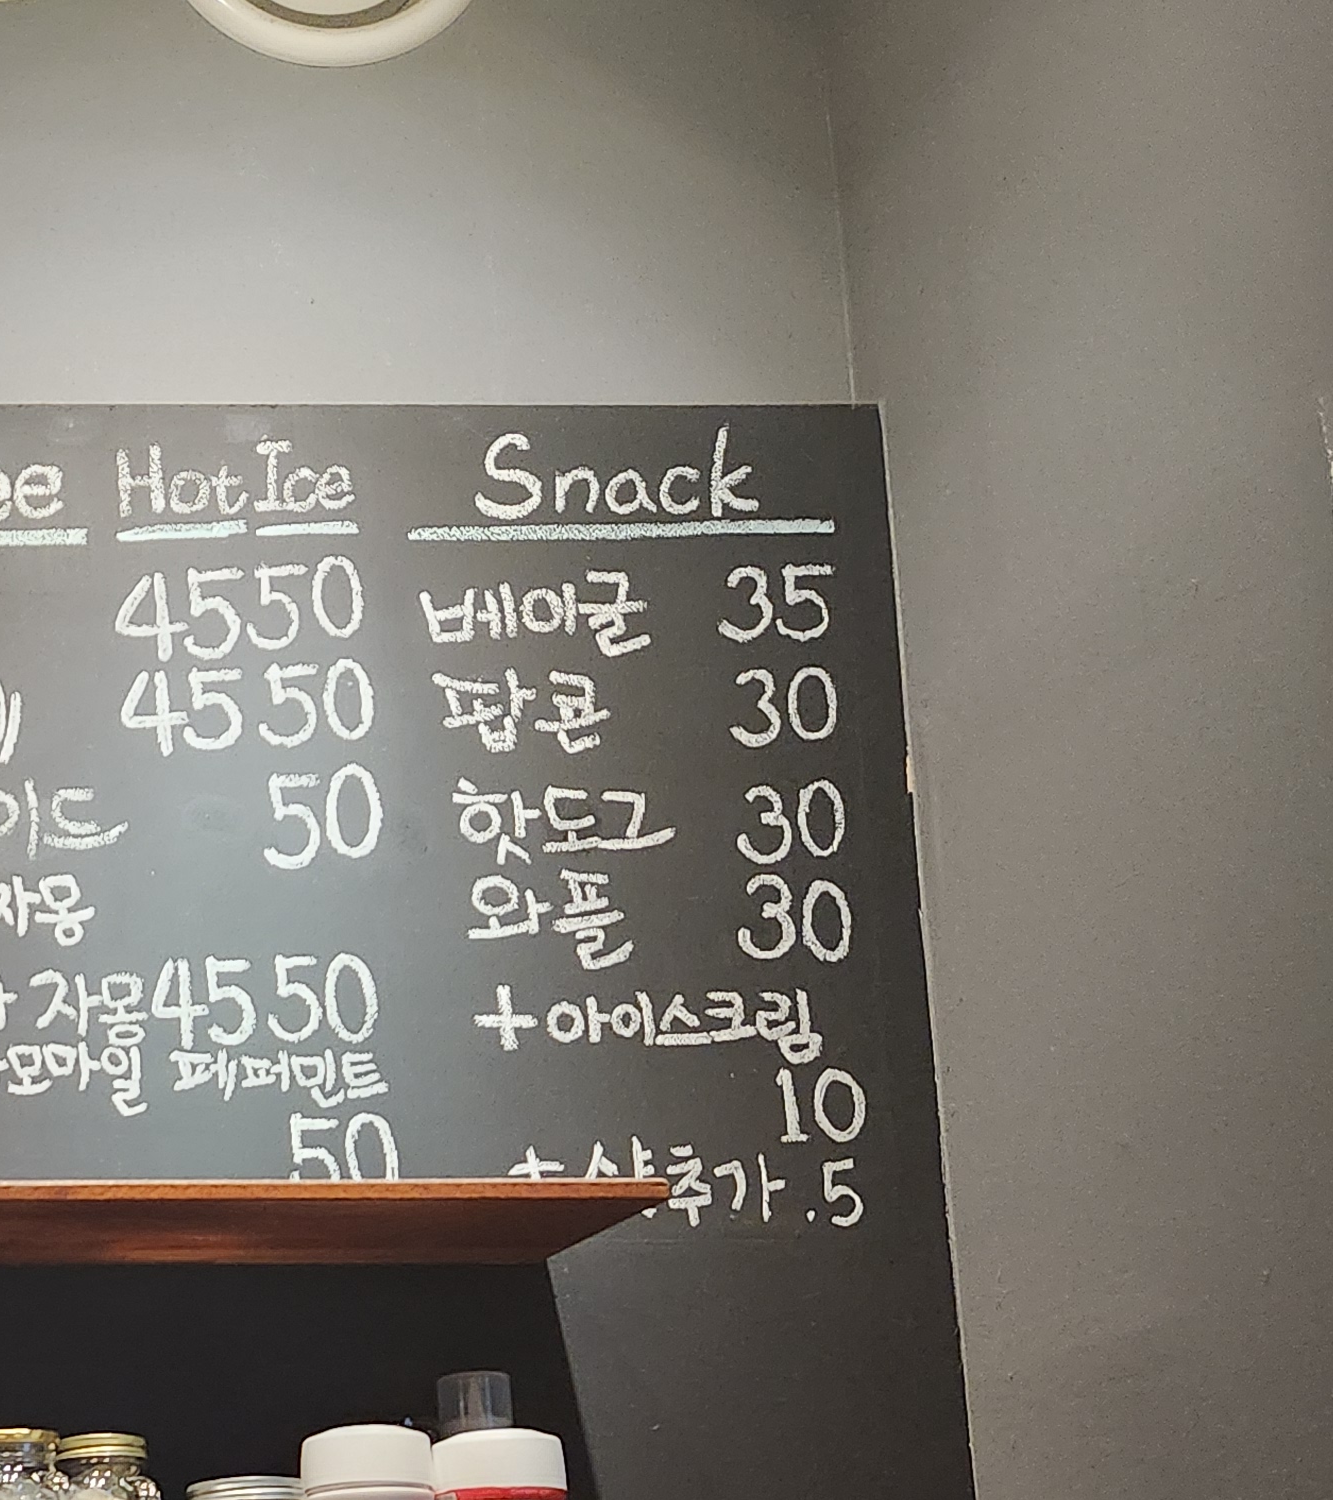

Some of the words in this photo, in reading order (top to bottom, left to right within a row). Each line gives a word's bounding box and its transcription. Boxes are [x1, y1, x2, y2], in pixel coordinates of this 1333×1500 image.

[116, 441, 249, 518] Hot
[254, 437, 356, 512] Ice
[474, 423, 761, 520] Snack
[115, 566, 245, 662] 45
[246, 554, 364, 651] 50
[717, 564, 837, 644] 35
[120, 667, 244, 758] 45
[259, 658, 375, 749] 50
[432, 666, 611, 755] 팝콘
[730, 665, 838, 749] 30
[264, 762, 384, 870] 50
[453, 776, 677, 865] 핫도그
[736, 778, 847, 865] 30
[468, 868, 635, 970] 와플
[737, 873, 852, 962] 30
[29, 969, 149, 1047] 자몽
[151, 954, 258, 1051] 45
[267, 952, 379, 1044] 50
[169, 1048, 391, 1109] 페퍼민트
[775, 1066, 867, 1144] 10
[289, 1112, 400, 1182] 50
